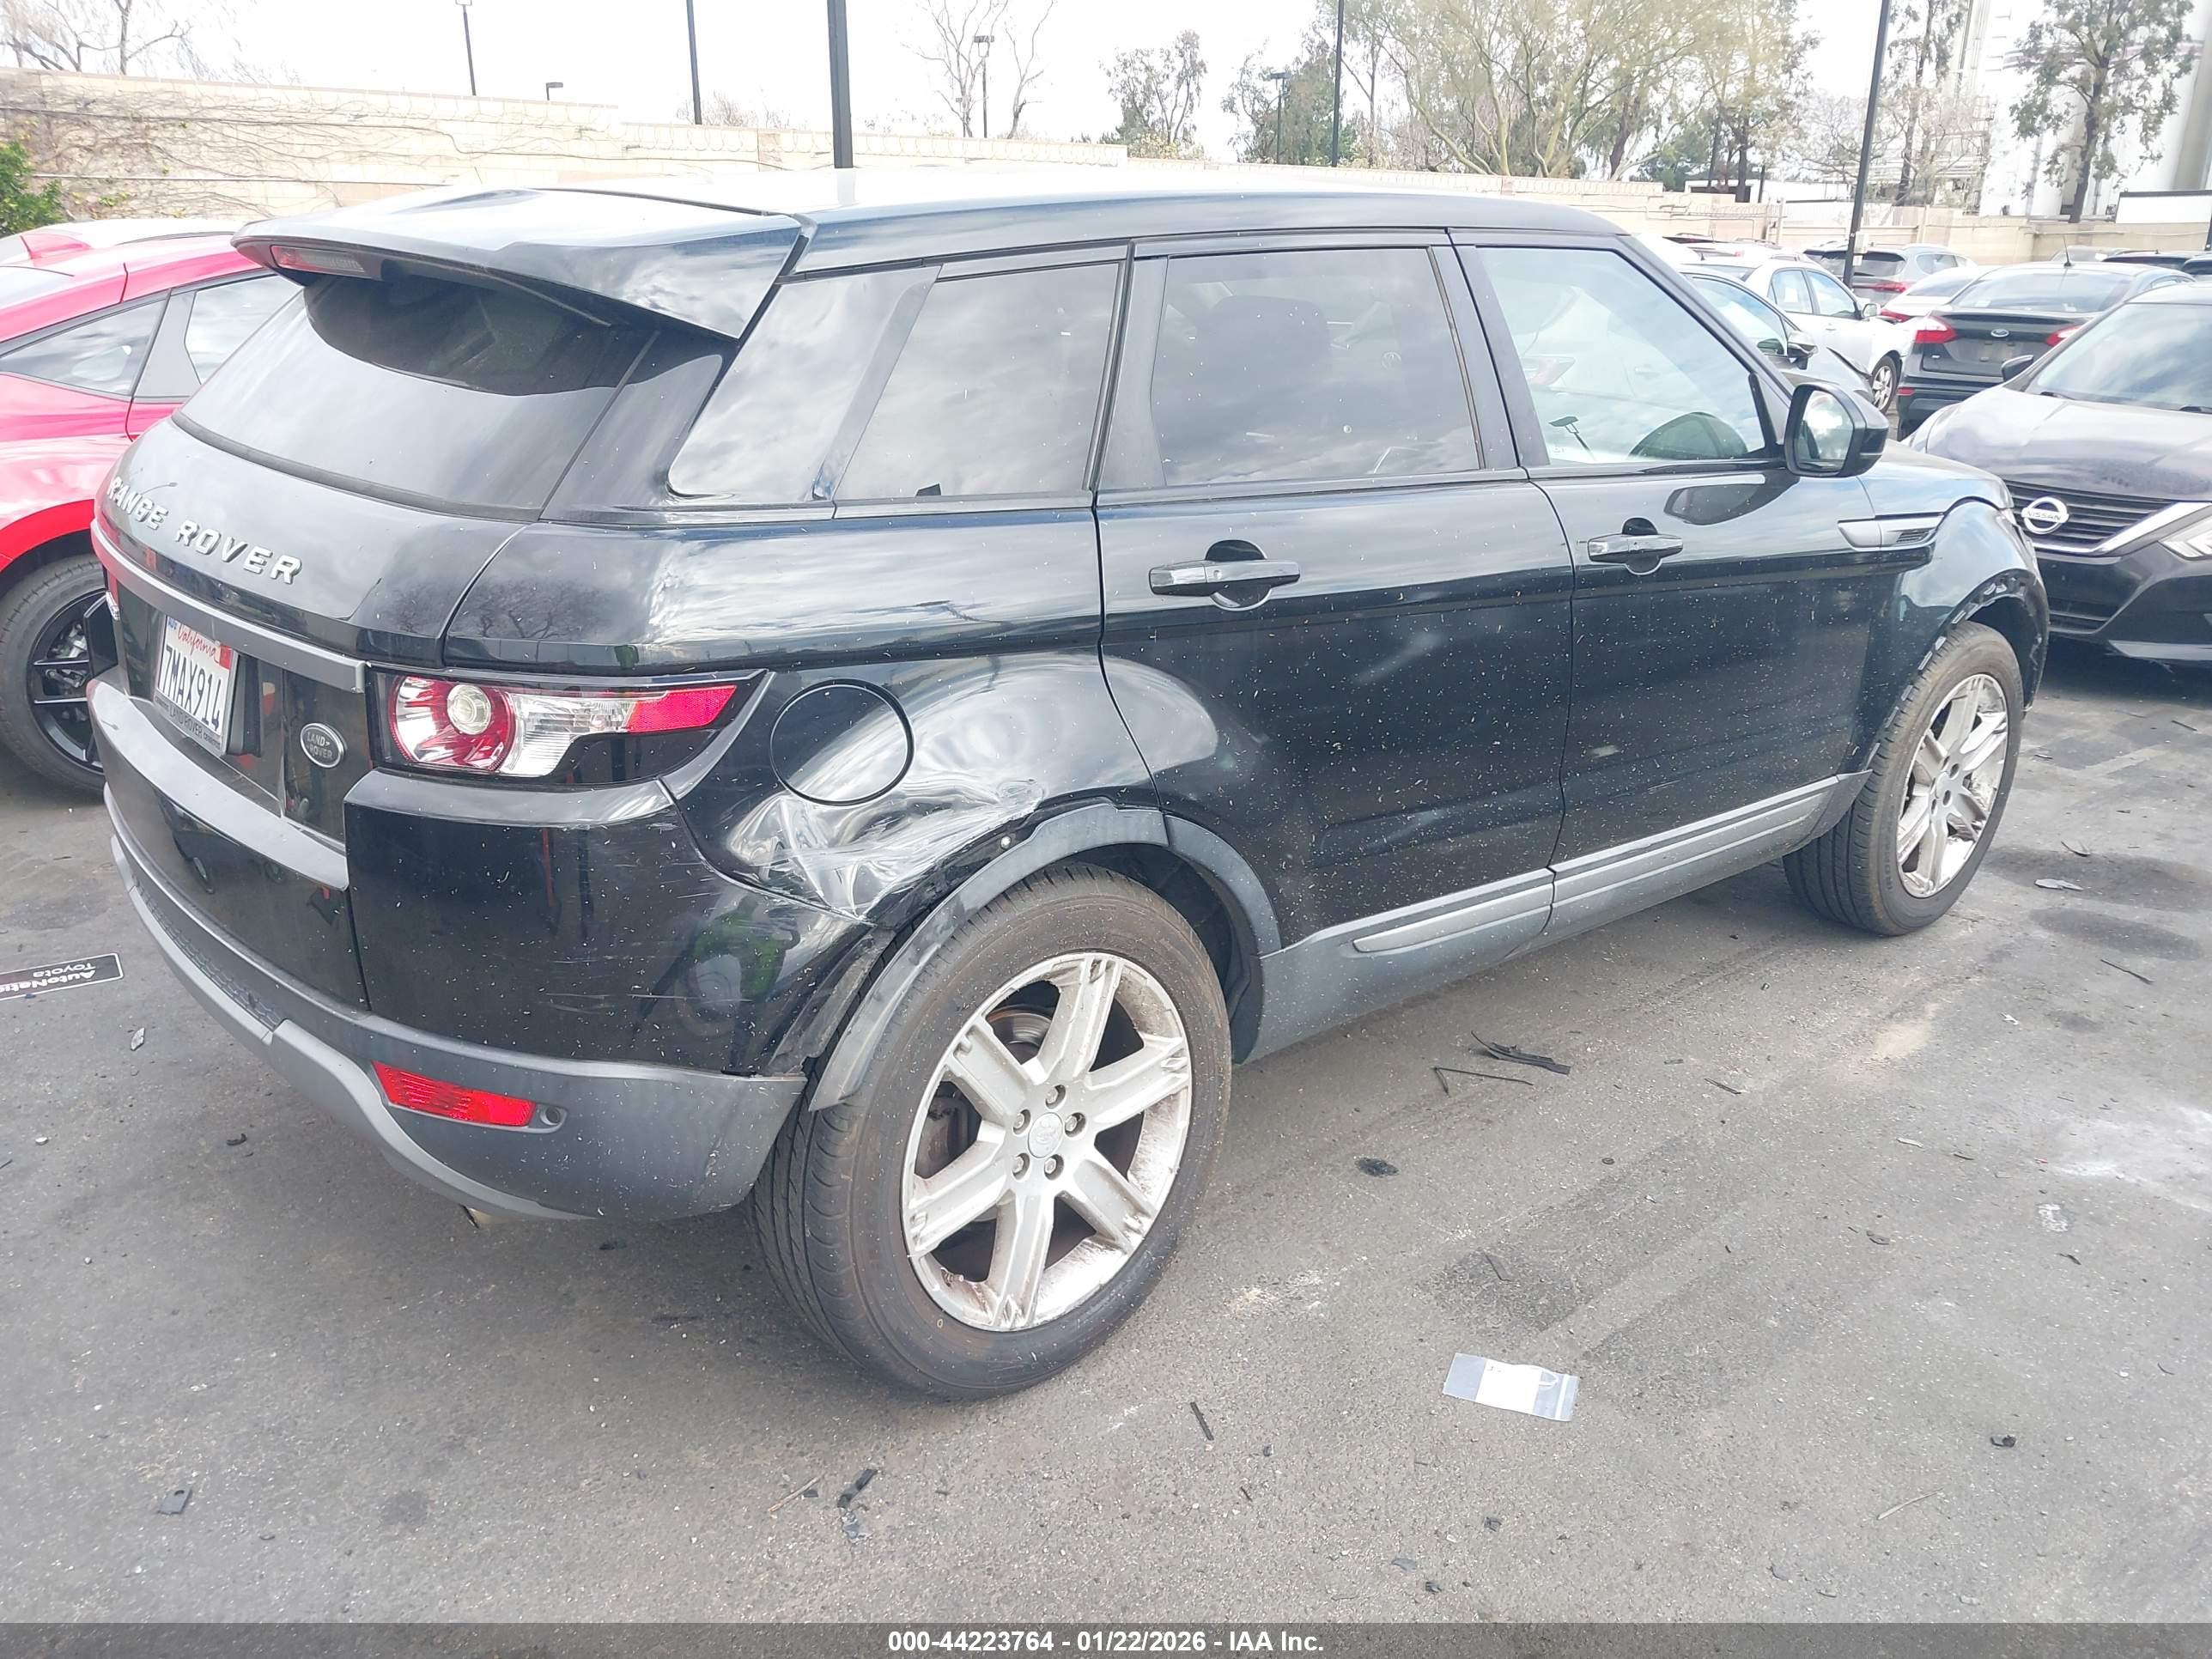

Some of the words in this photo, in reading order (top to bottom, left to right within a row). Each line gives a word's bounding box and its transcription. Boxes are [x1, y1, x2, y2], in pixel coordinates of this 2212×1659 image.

[2027, 510, 2062, 520] NISSAN
[107, 477, 168, 530] RANGE
[175, 520, 302, 585] ROVER
[177, 623, 218, 657] California
[162, 645, 222, 732] 7MAX914
[307, 732, 325, 746] LAND
[309, 744, 333, 759] ROVER
[33, 963, 96, 978] Toyota
